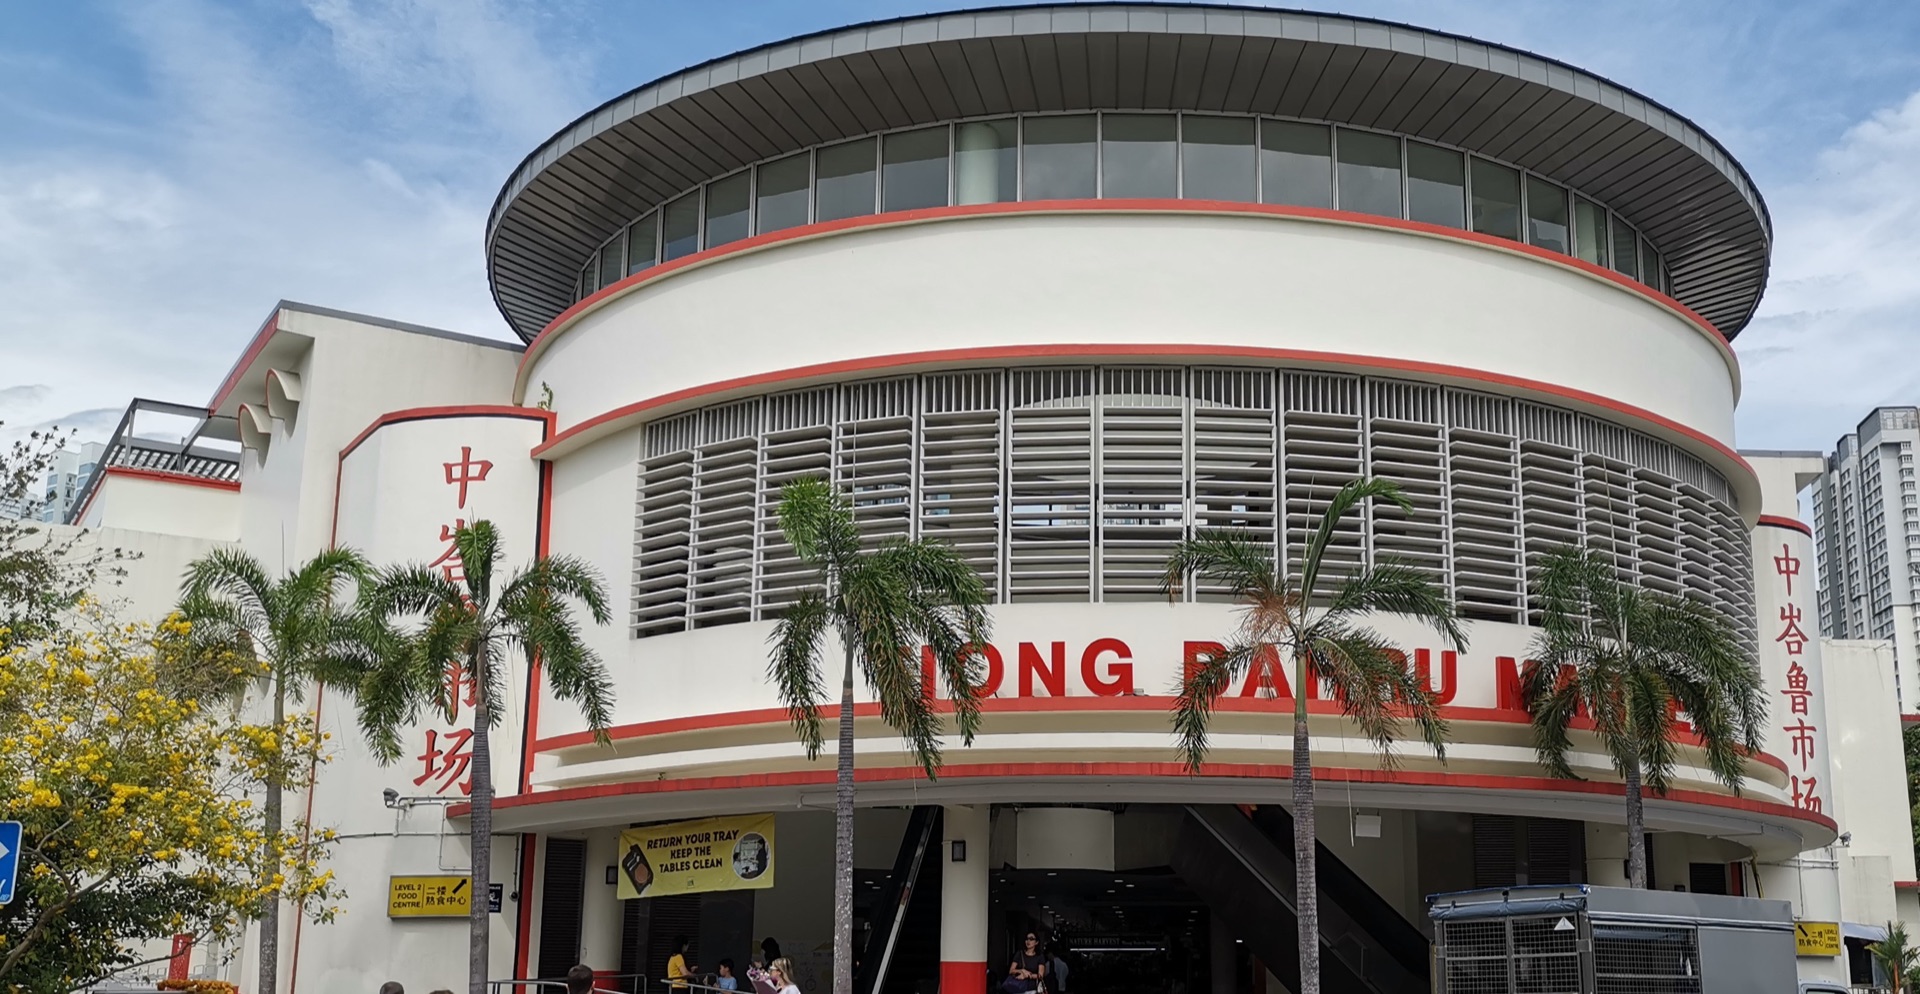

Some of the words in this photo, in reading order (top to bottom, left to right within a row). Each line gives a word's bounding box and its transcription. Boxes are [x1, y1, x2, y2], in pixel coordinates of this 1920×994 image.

[897, 638, 1134, 699] IONG
[647, 836, 683, 849] RETURN
[685, 832, 711, 845] YOUR
[713, 829, 739, 841] TRAY
[670, 848, 692, 859] KEEP
[694, 846, 711, 856] THE
[659, 861, 690, 873] TABLES
[693, 858, 722, 870] CLEAN
[417, 883, 422, 891] 2
[397, 892, 417, 900] FOOD
[392, 901, 421, 909] CENTRE
